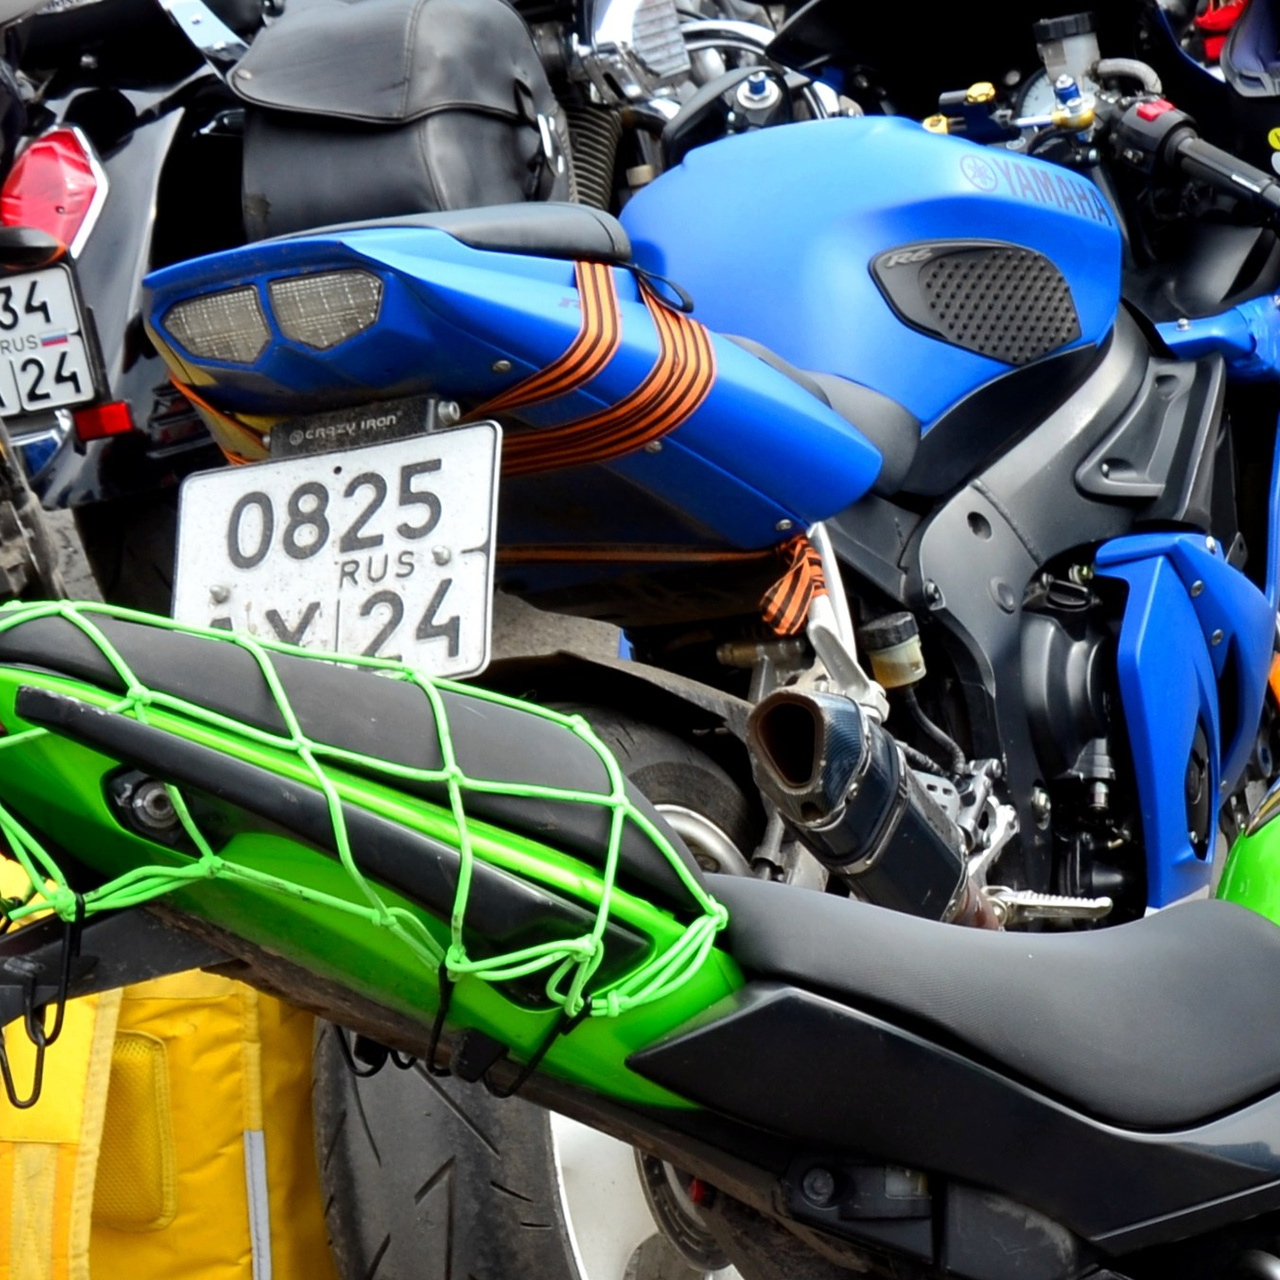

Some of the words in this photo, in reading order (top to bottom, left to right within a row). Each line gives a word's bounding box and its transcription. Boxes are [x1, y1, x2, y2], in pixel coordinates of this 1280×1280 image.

[992, 157, 1113, 227] YAMAHA
[885, 249, 932, 268] R6
[0, 334, 39, 356] RUS
[20, 351, 82, 403] 24
[305, 422, 356, 440] CRAZY
[227, 458, 442, 569] 0825
[340, 551, 415, 588] RUS
[359, 578, 461, 671] 24
